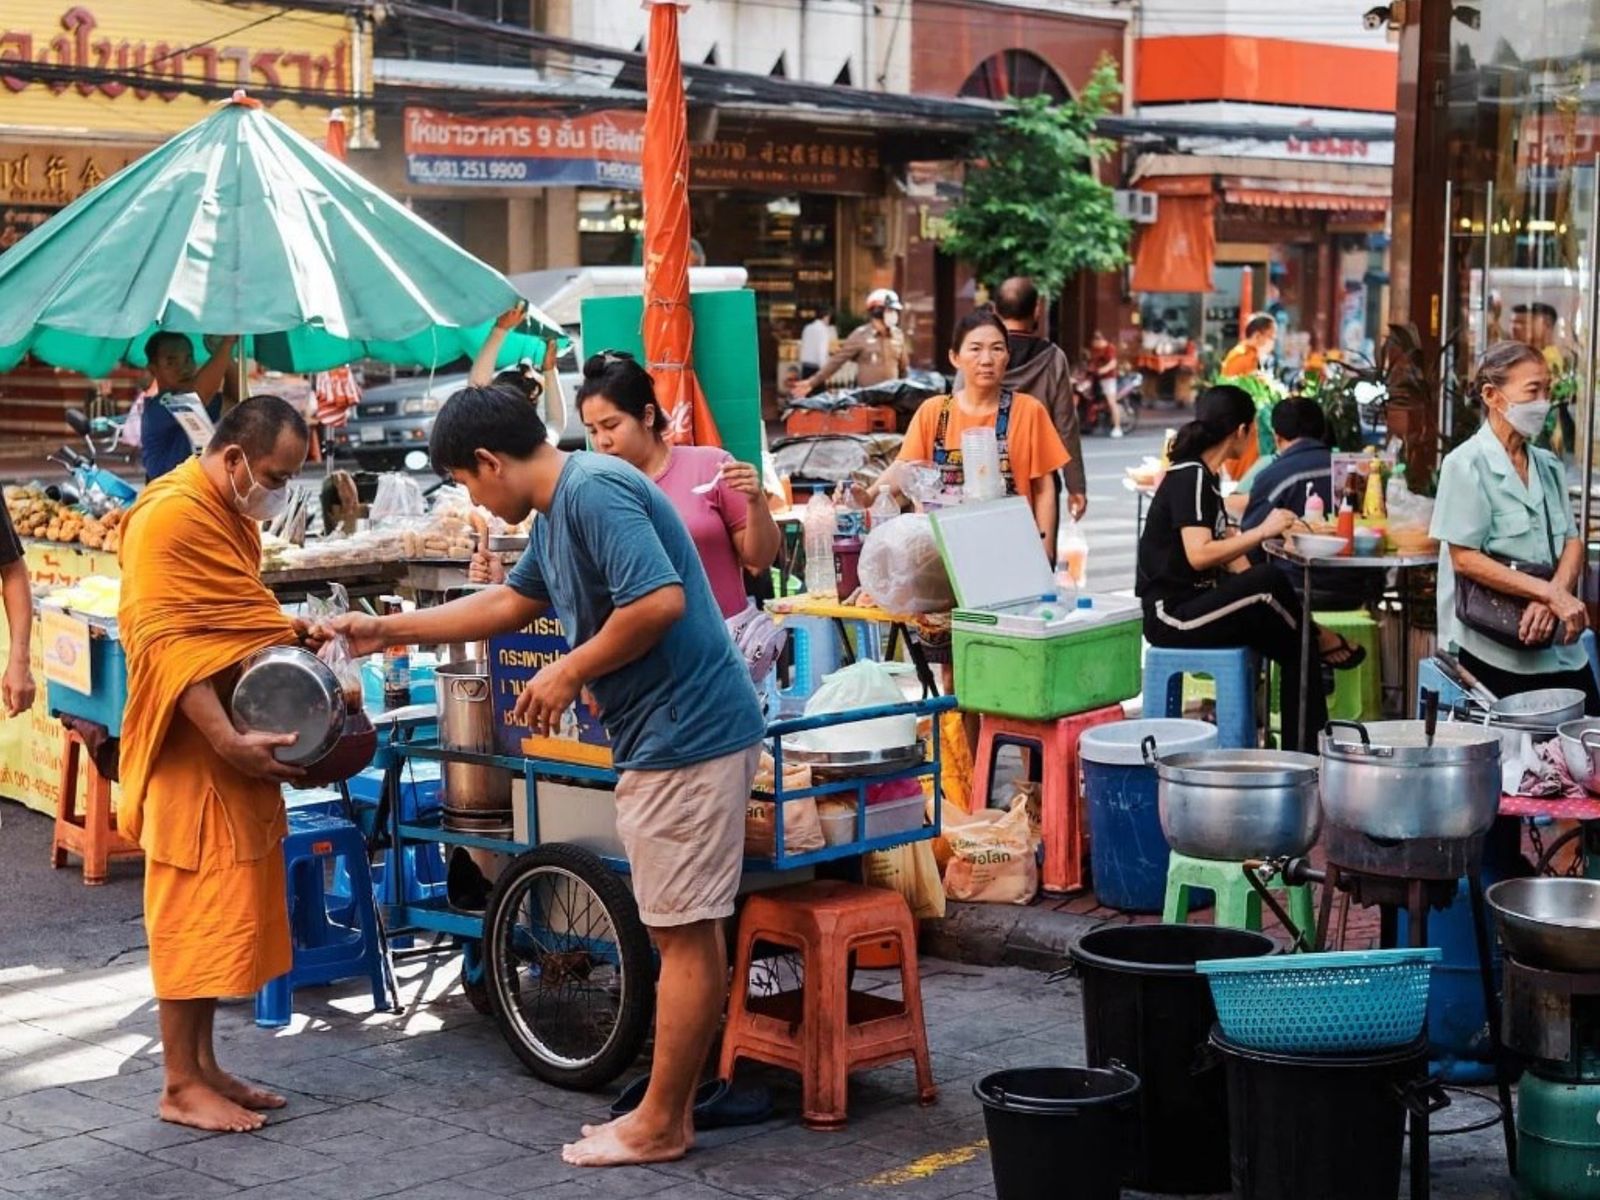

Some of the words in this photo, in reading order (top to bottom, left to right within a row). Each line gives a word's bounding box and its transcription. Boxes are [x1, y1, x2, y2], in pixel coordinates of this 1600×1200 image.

[537, 125, 552, 148] 9
[460, 161, 488, 178] 251
[489, 161, 527, 179] 9900
